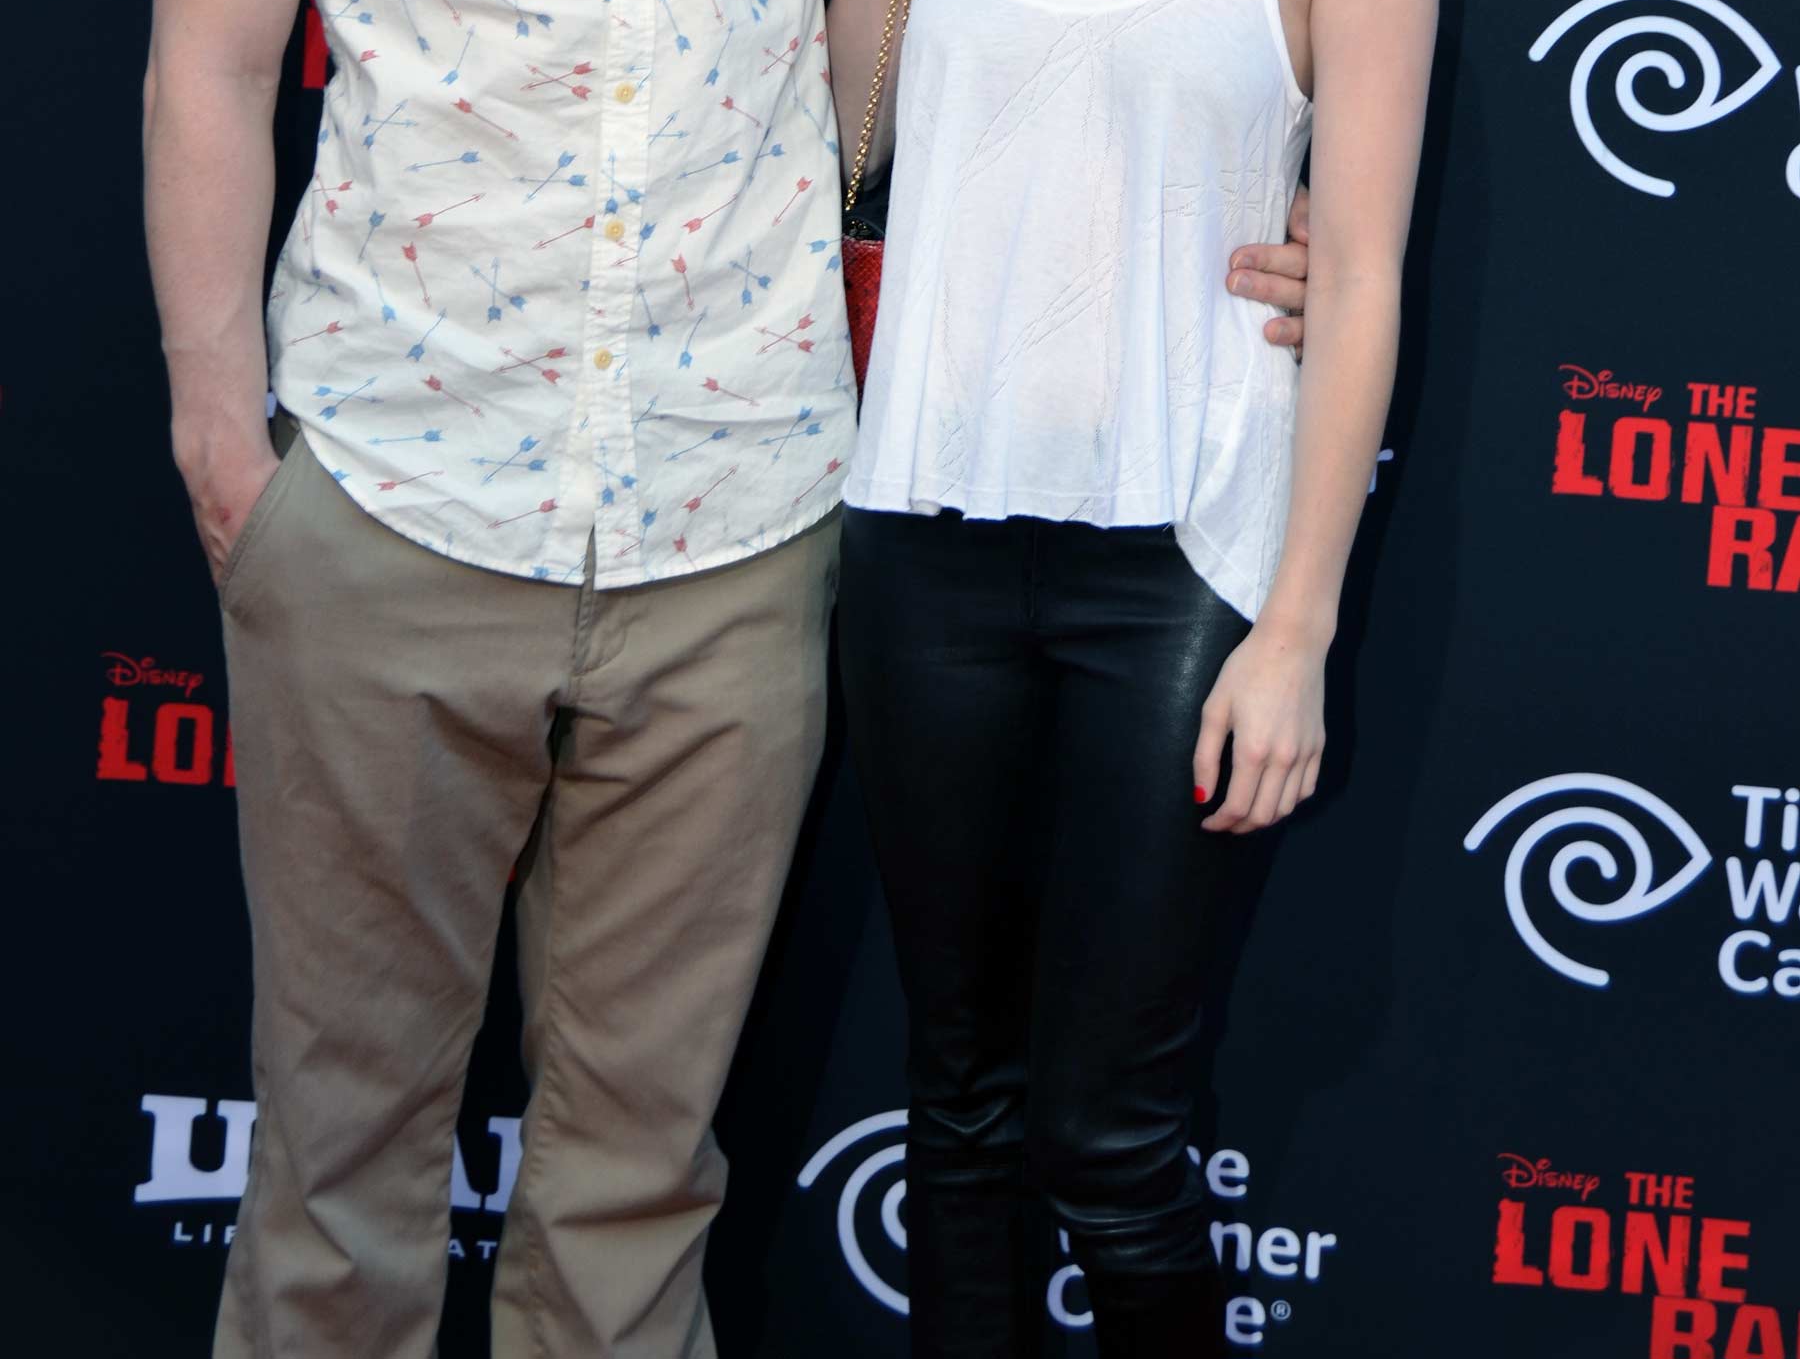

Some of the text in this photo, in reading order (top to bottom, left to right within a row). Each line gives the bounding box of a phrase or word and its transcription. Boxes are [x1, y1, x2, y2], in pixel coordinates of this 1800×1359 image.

[1686, 382, 1757, 420] THE
[1551, 408, 1800, 512] LONE
[96, 695, 236, 788] LO
[1624, 1171, 1694, 1210] THE
[1492, 1197, 1751, 1304] LONE
